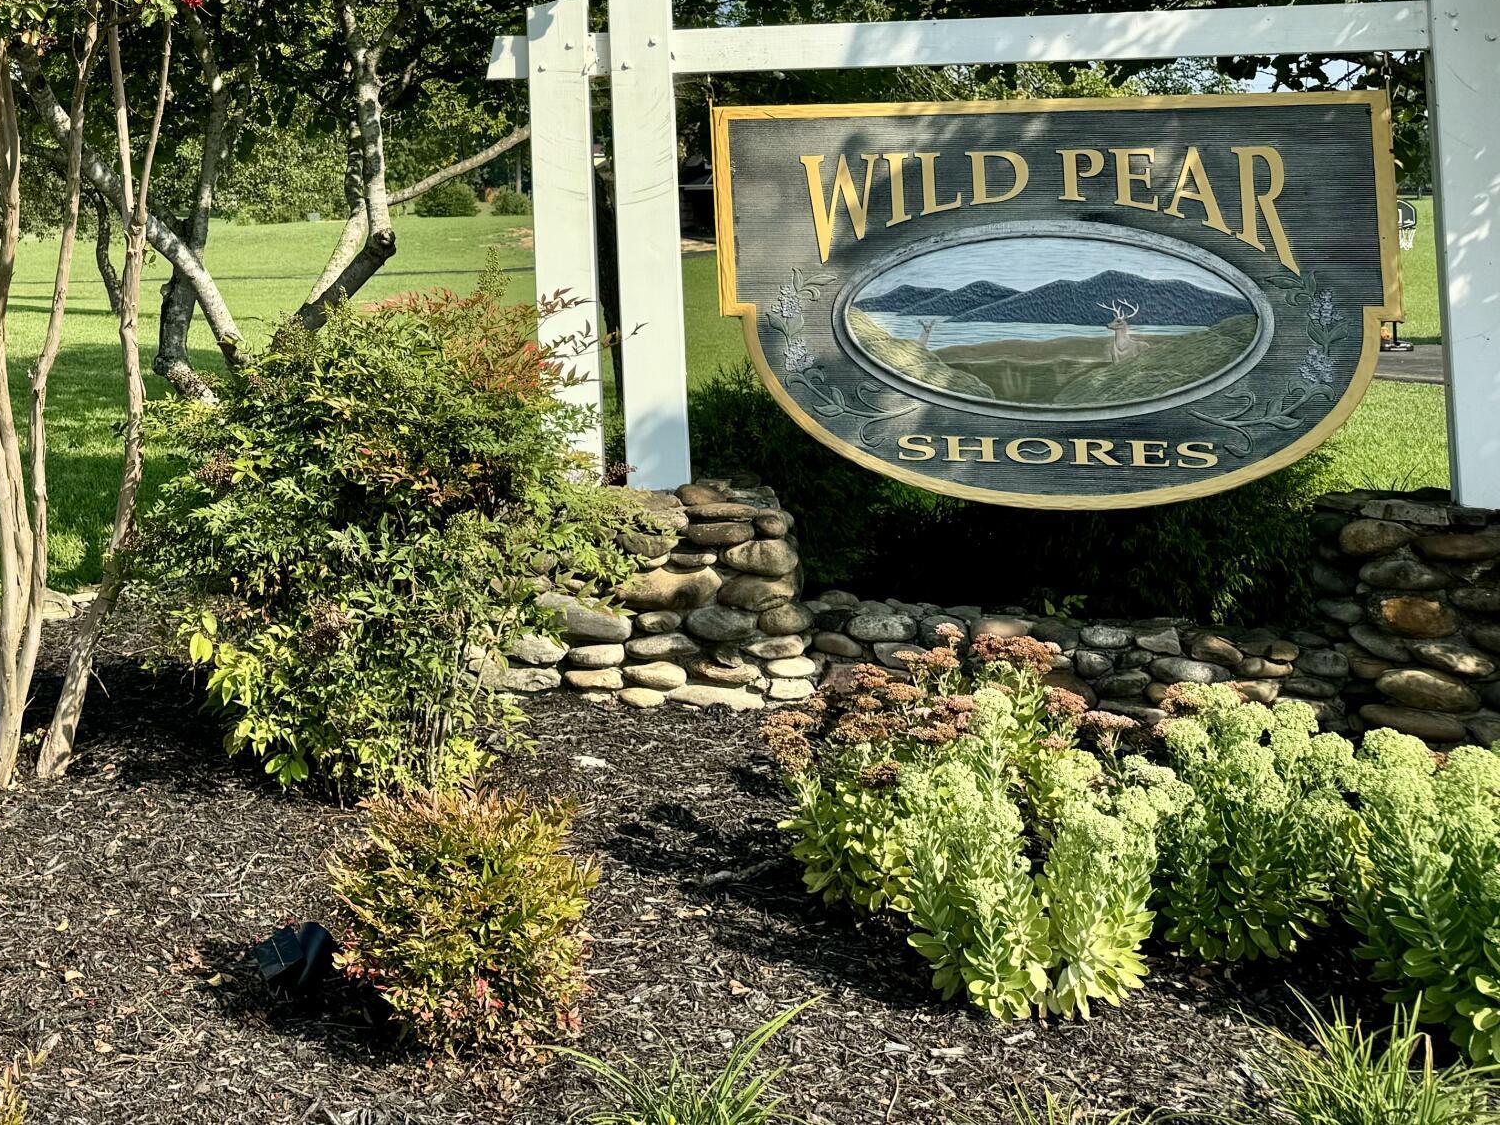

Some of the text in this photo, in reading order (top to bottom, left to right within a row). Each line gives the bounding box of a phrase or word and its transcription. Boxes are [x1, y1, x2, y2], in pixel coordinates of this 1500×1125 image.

[799, 146, 1301, 275] WILD PEAR
[897, 434, 1219, 470] SHORES
